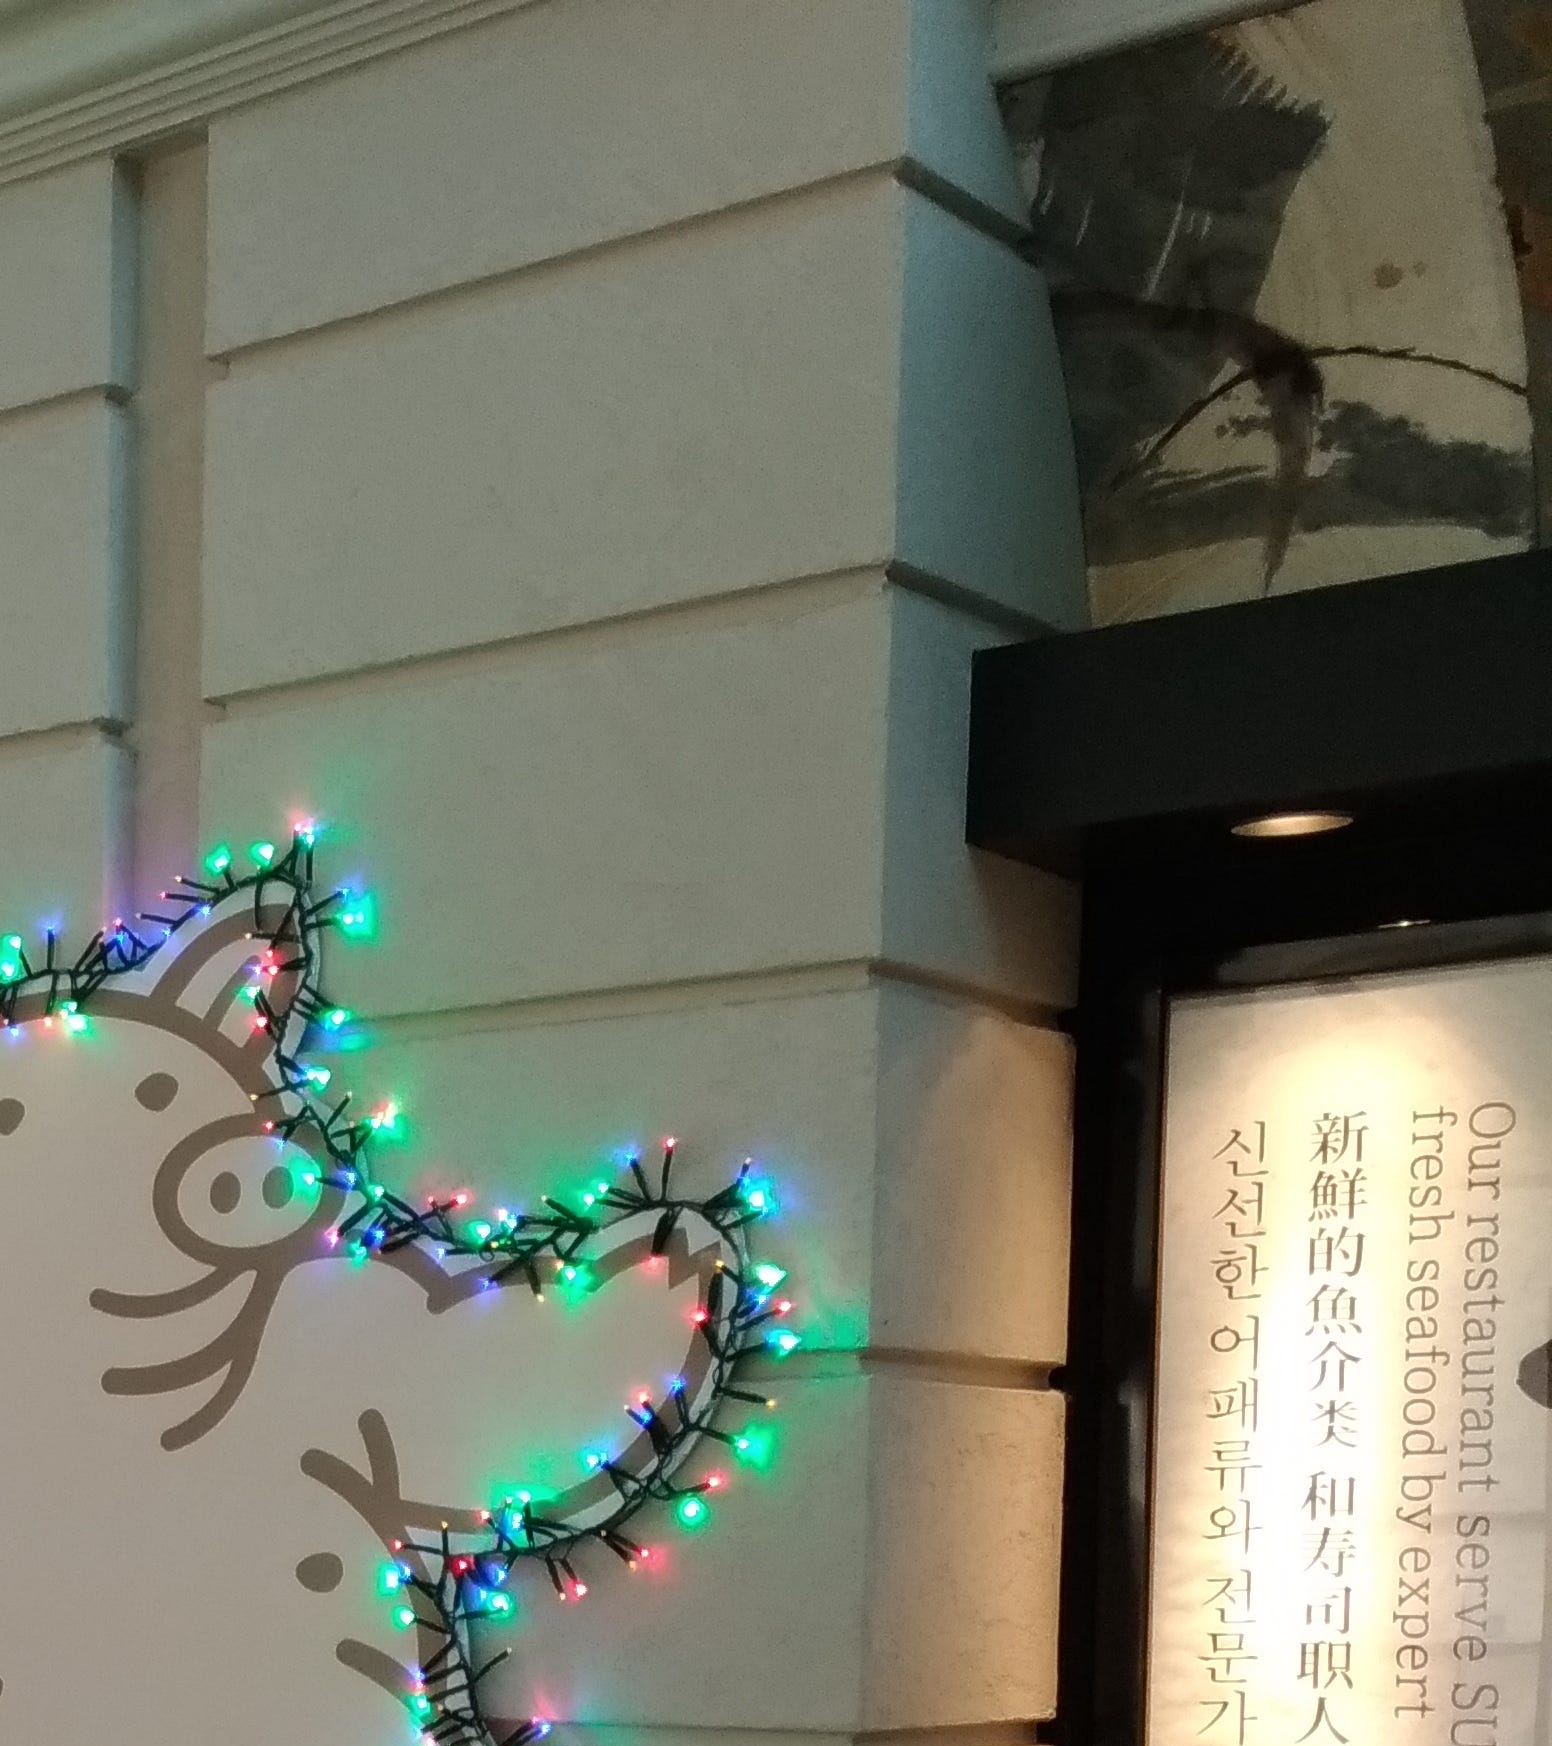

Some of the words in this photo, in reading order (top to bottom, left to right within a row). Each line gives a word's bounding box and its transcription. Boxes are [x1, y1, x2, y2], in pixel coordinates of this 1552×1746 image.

[1209, 1119, 1270, 1302] 신선한
[1408, 1106, 1458, 1241] fresh
[1466, 1101, 1517, 1199] Our
[1203, 1315, 1262, 1553] 어패류와
[1401, 1262, 1449, 1459] seafood
[1457, 1212, 1504, 1493] restaurant
[1396, 1475, 1448, 1533] by
[1452, 1516, 1491, 1661] serve
[1393, 1546, 1434, 1719] expert
